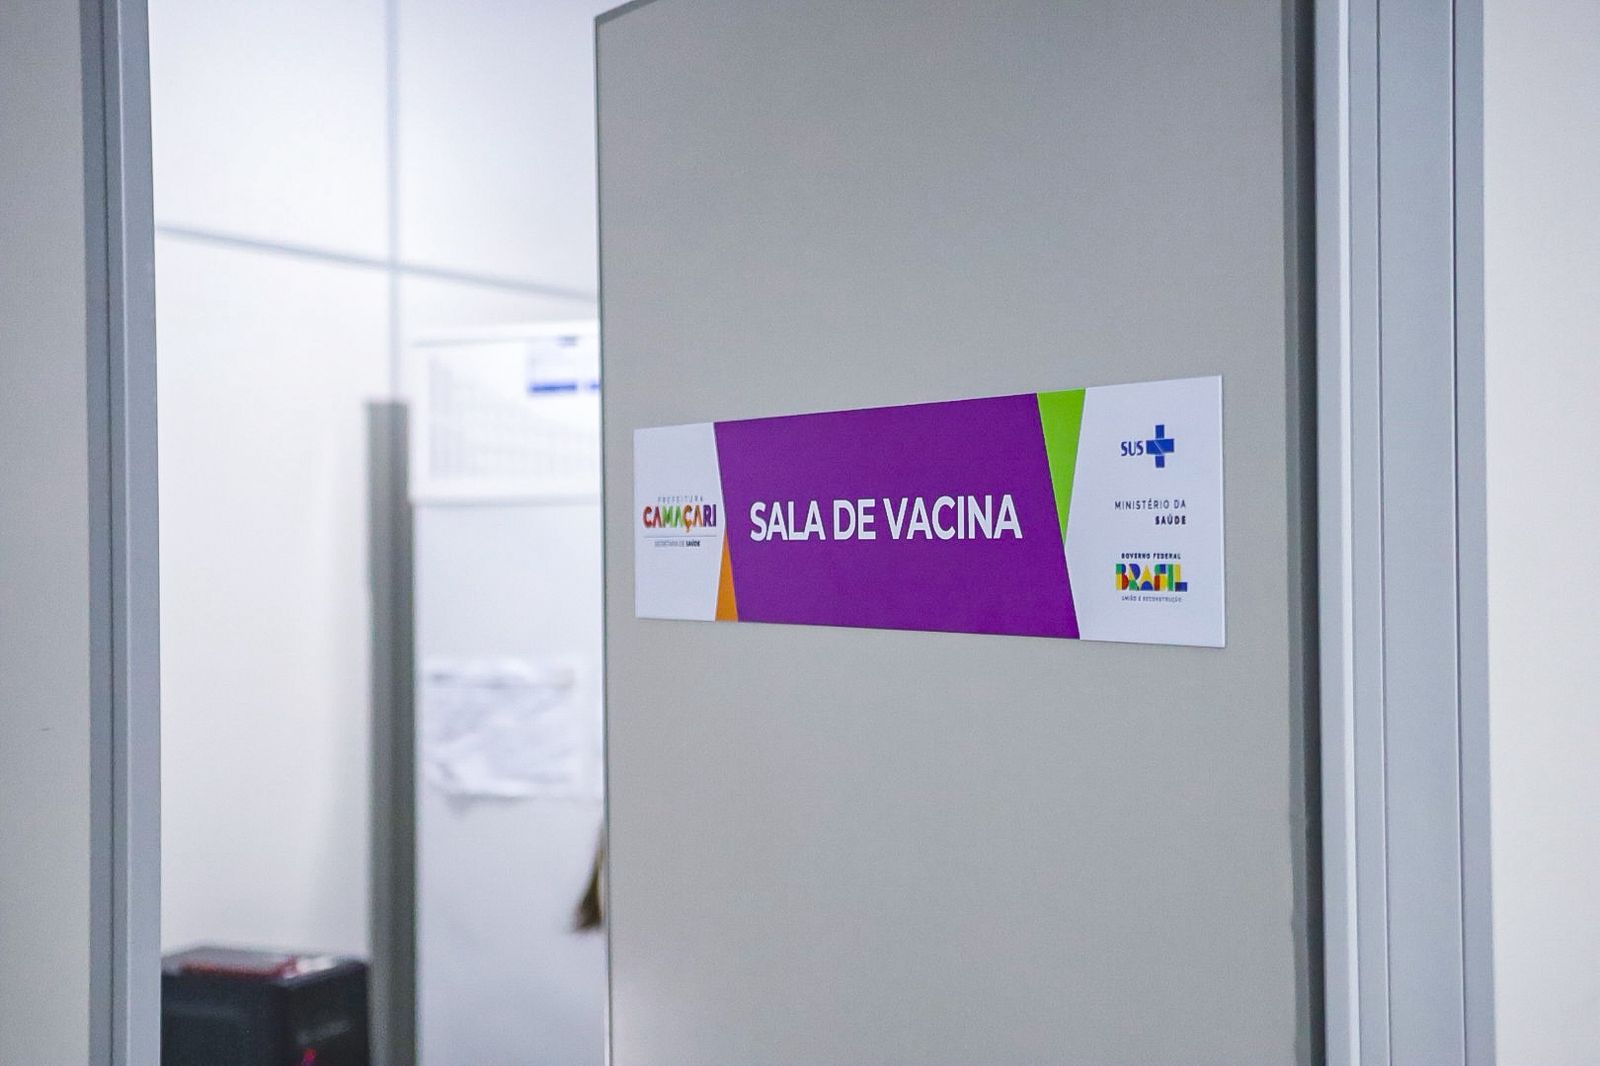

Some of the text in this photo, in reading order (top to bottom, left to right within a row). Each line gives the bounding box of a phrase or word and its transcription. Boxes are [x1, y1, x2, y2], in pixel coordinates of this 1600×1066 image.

[1121, 440, 1144, 457] SUS
[1114, 498, 1186, 510] MINISTÉRIO DA
[643, 504, 717, 533] CAMAÇARI
[749, 494, 1023, 542] SALA DE VACINA
[1155, 513, 1186, 525] SAÚDE
[1115, 563, 1188, 592] BRASIL
